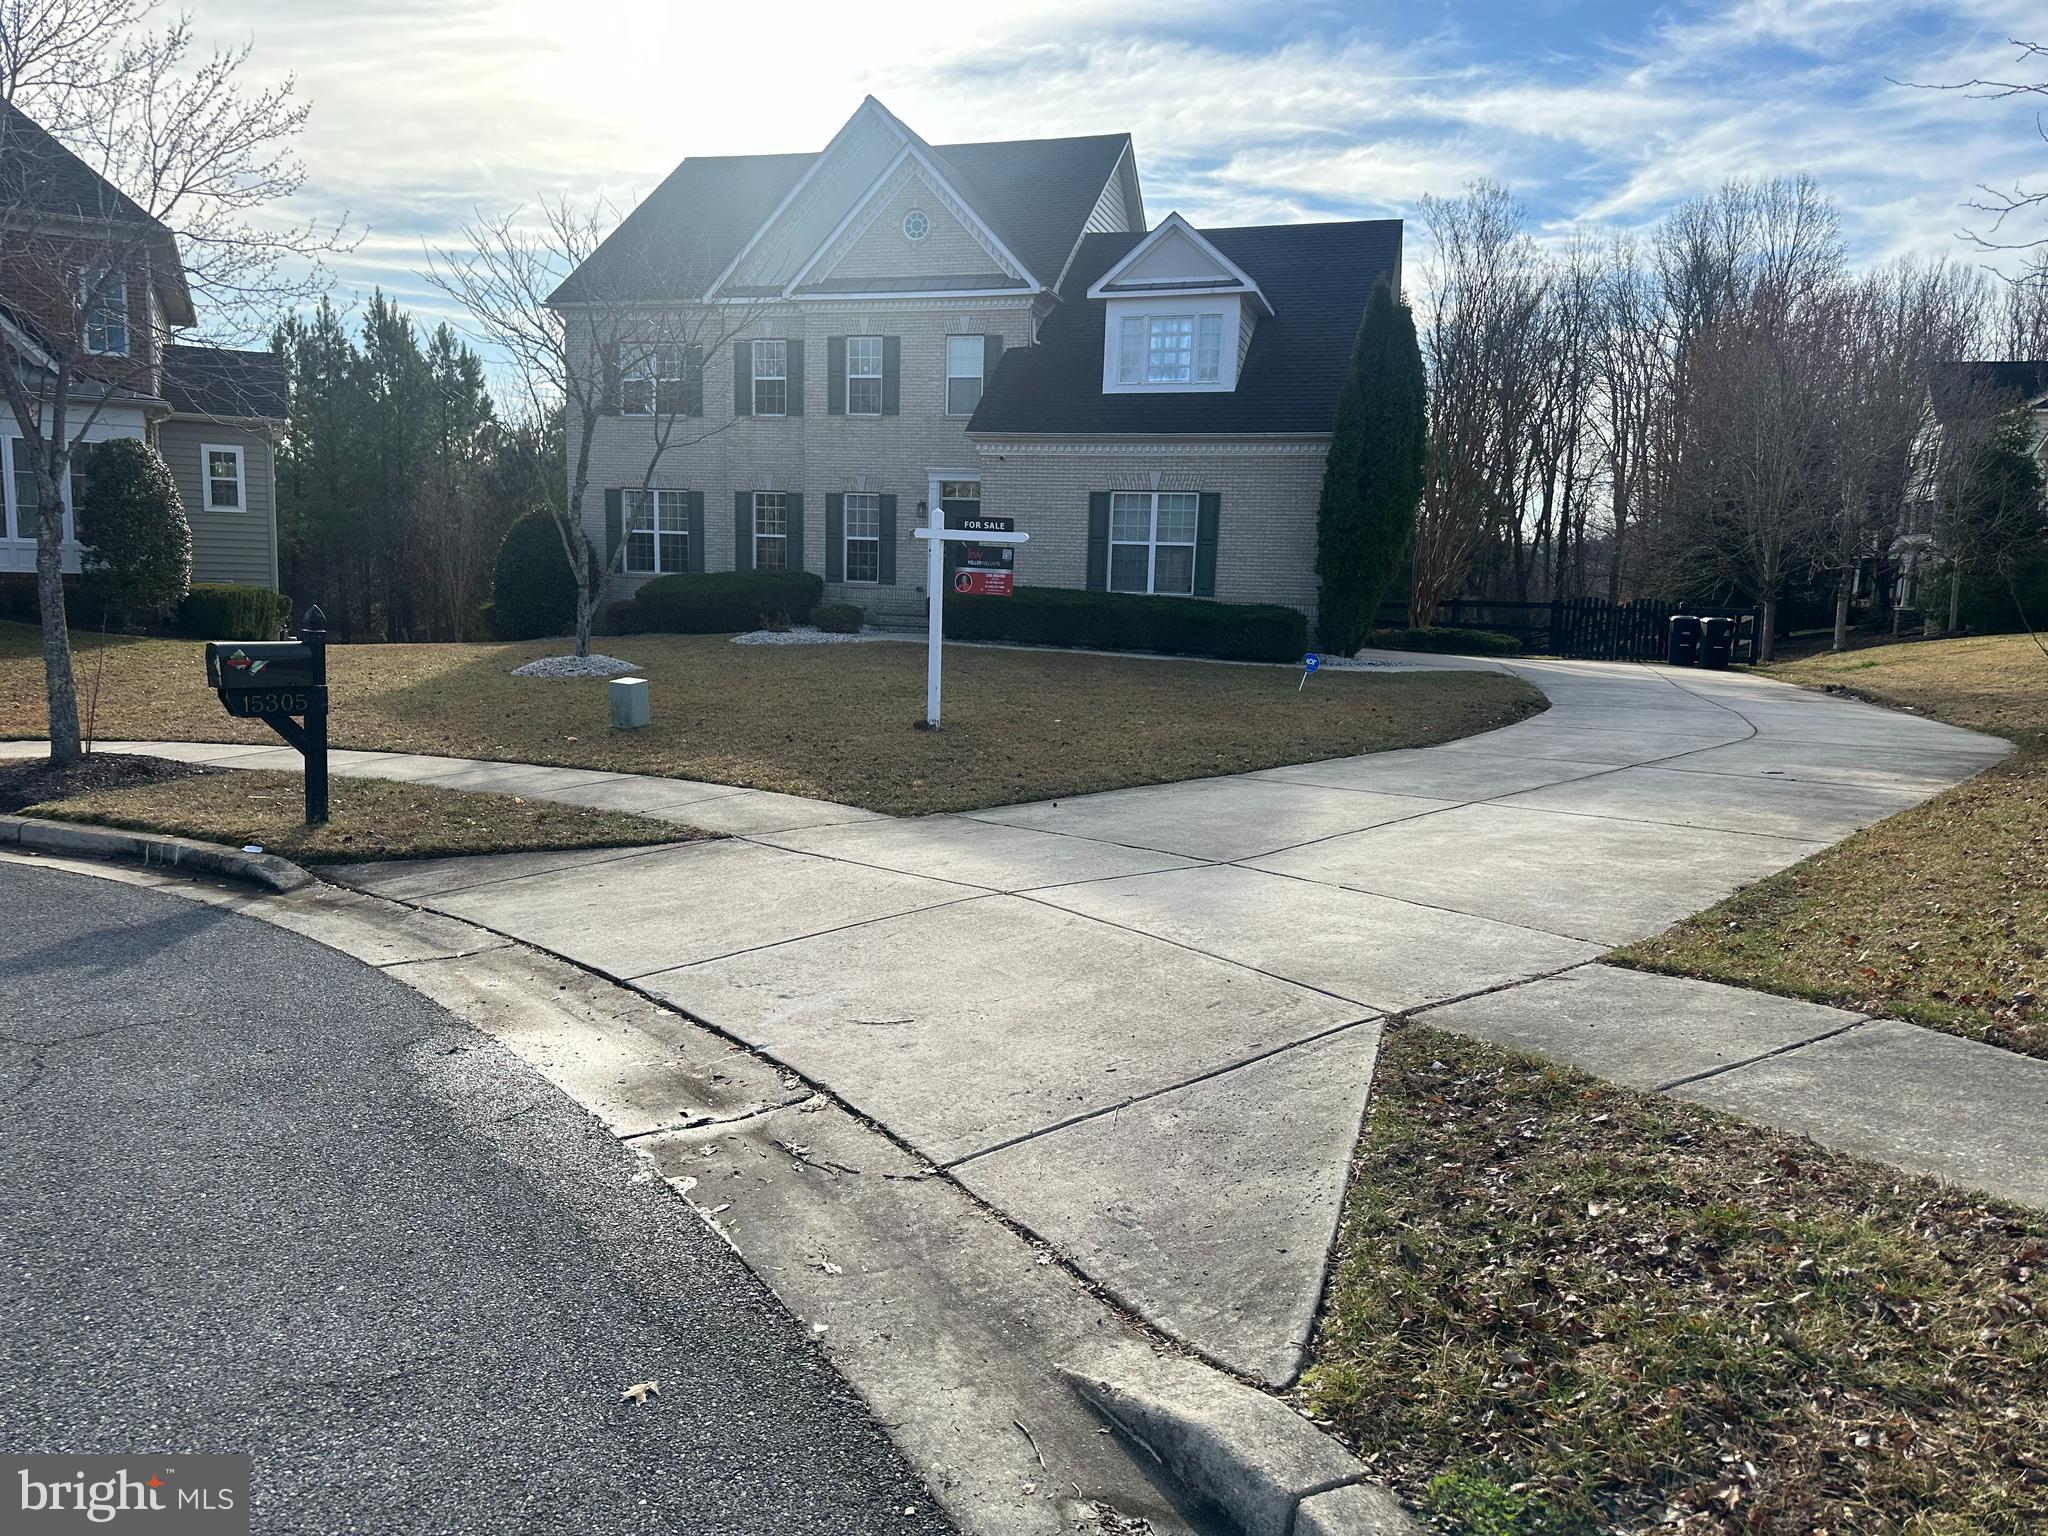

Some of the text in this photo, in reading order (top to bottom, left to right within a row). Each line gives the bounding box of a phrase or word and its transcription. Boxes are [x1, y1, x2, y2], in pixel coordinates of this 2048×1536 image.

[964, 520, 1005, 530] FOR SALE
[967, 547, 984, 560] kw
[243, 693, 308, 713] 15305
